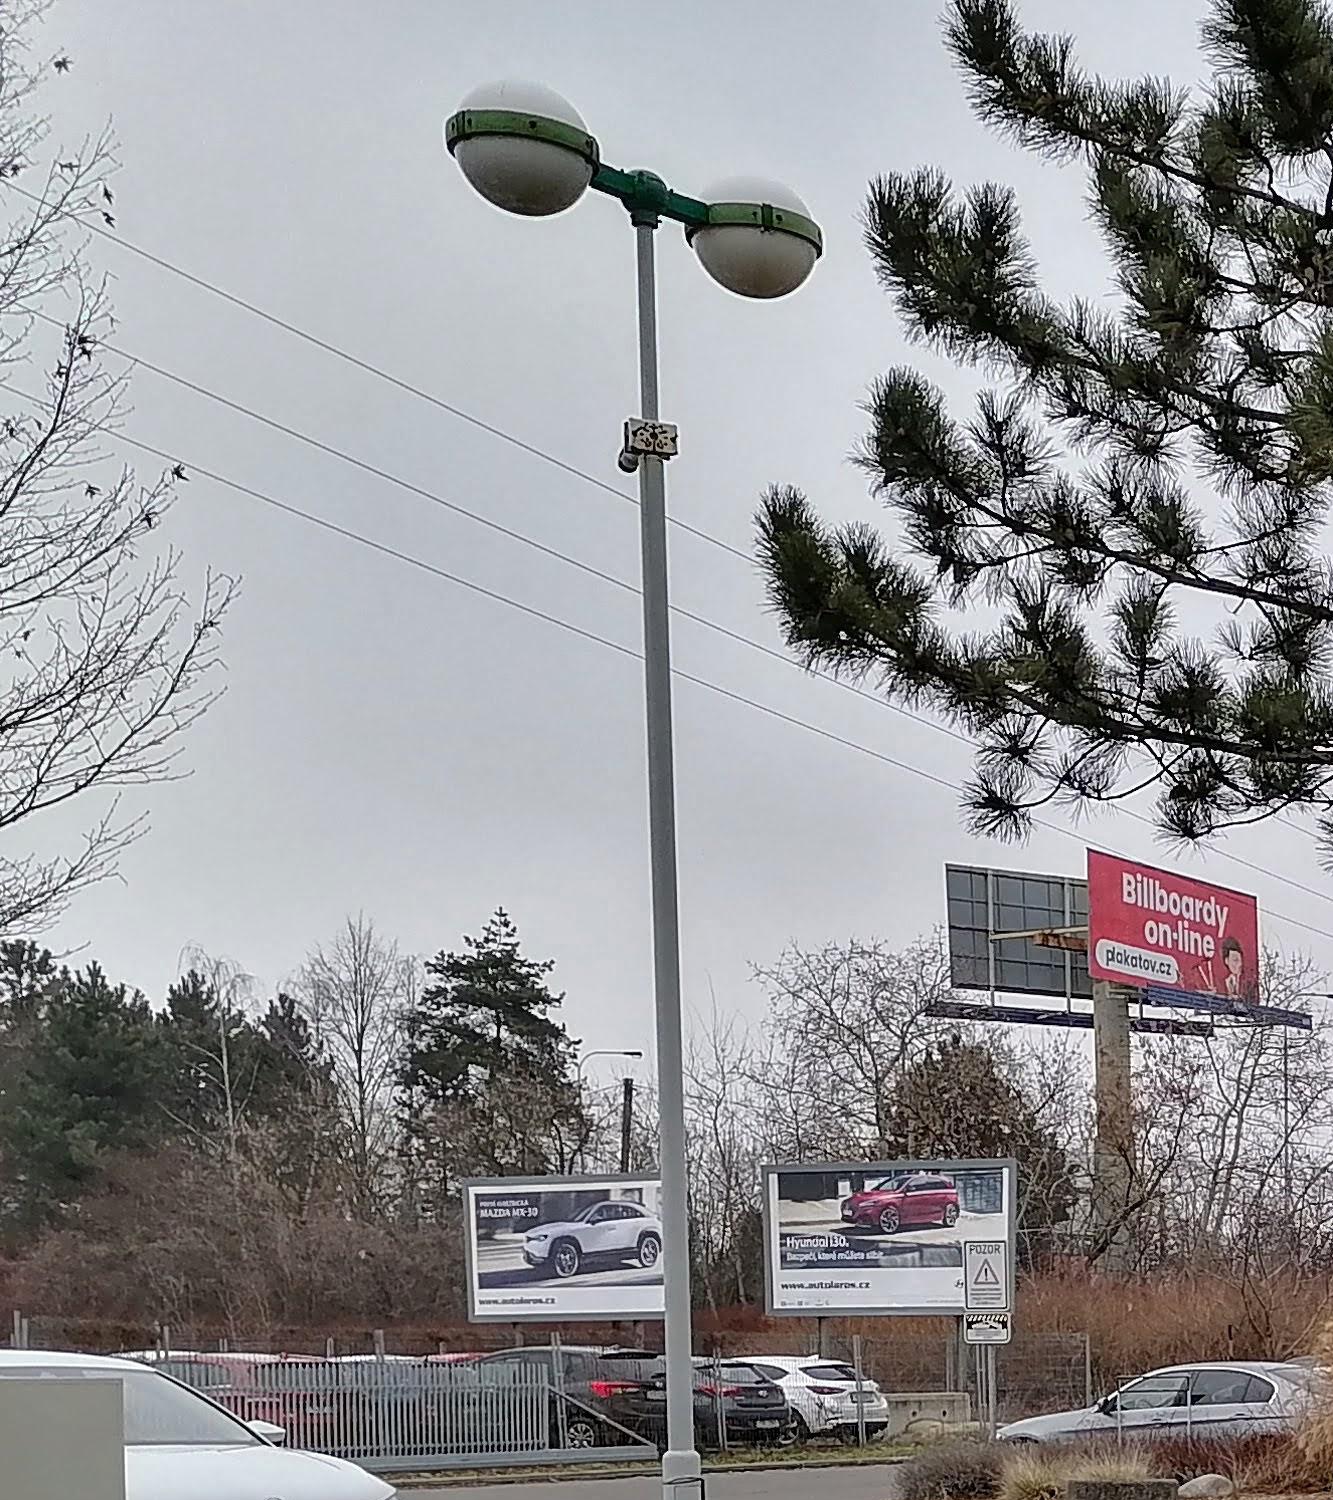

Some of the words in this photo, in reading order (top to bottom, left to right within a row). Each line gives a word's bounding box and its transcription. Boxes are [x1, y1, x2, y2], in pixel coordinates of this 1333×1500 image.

[1122, 872, 1229, 938] Billboardy
[1144, 920, 1215, 958] on-line
[1105, 946, 1172, 977] plakatov.cz
[479, 1208, 511, 1218] MAZDA
[512, 1207, 539, 1218] MX-30
[786, 1236, 829, 1249] Hyundai
[969, 1244, 1001, 1254] POZOR
